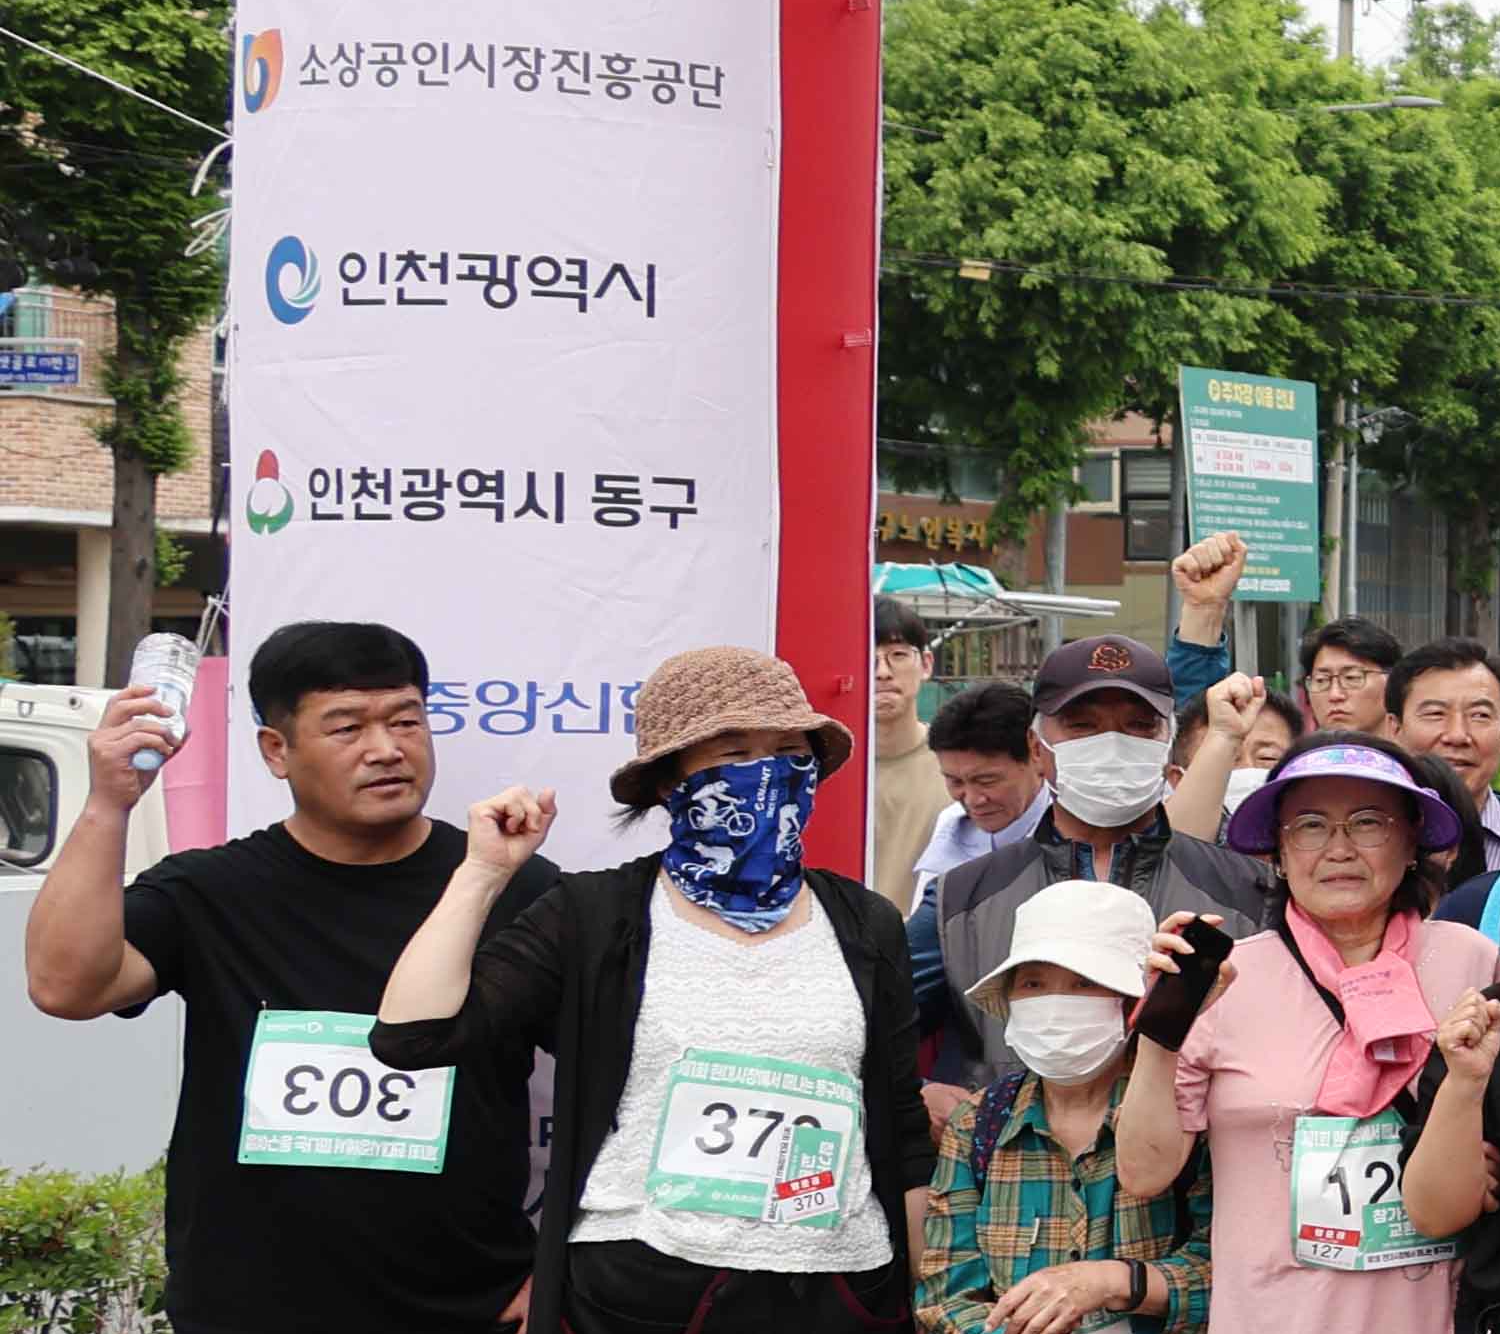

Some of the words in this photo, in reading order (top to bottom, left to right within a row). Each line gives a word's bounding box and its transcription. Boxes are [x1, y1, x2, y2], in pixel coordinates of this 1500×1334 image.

[298, 42, 726, 110] 소상공인시장진흥공단
[337, 249, 658, 319] 인천광역시
[307, 467, 567, 525] 인천광역시
[590, 470, 701, 531] 동구
[283, 1064, 416, 1122] 303
[793, 1192, 826, 1212] 370
[1328, 1160, 1402, 1216] 12
[1311, 1243, 1344, 1260] 127
